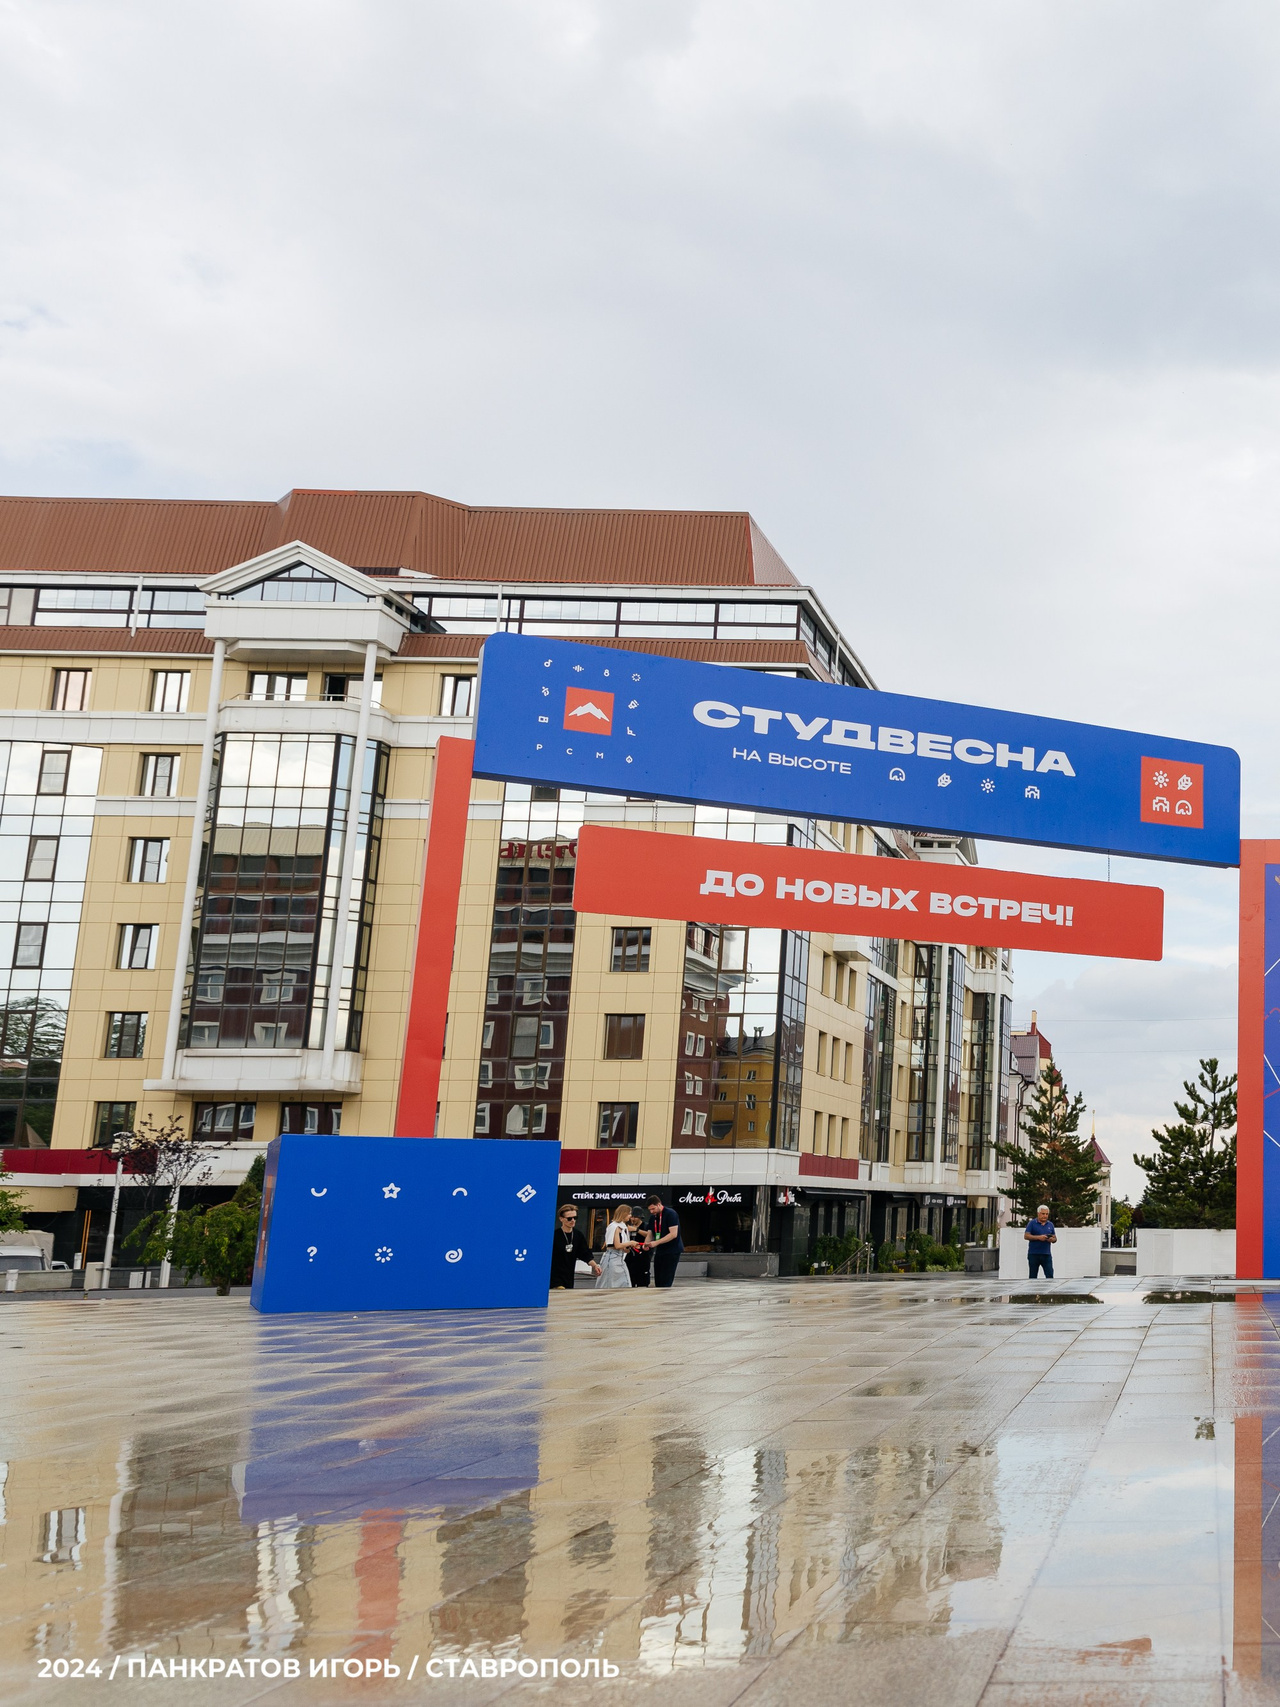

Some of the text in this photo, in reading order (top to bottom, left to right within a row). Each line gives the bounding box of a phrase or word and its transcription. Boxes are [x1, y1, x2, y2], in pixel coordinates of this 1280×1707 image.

[692, 700, 1076, 777] СТУДВЕСНА
[732, 747, 852, 775] НА ВЫСОТЕ
[699, 869, 1074, 927] ДО НОВЫХ ВСТРЕЧ!
[572, 1191, 647, 1200] СТЕЙК ЭНД ФИШХАУС
[678, 1191, 705, 1204] Мясо
[716, 1190, 742, 1205] Рыба
